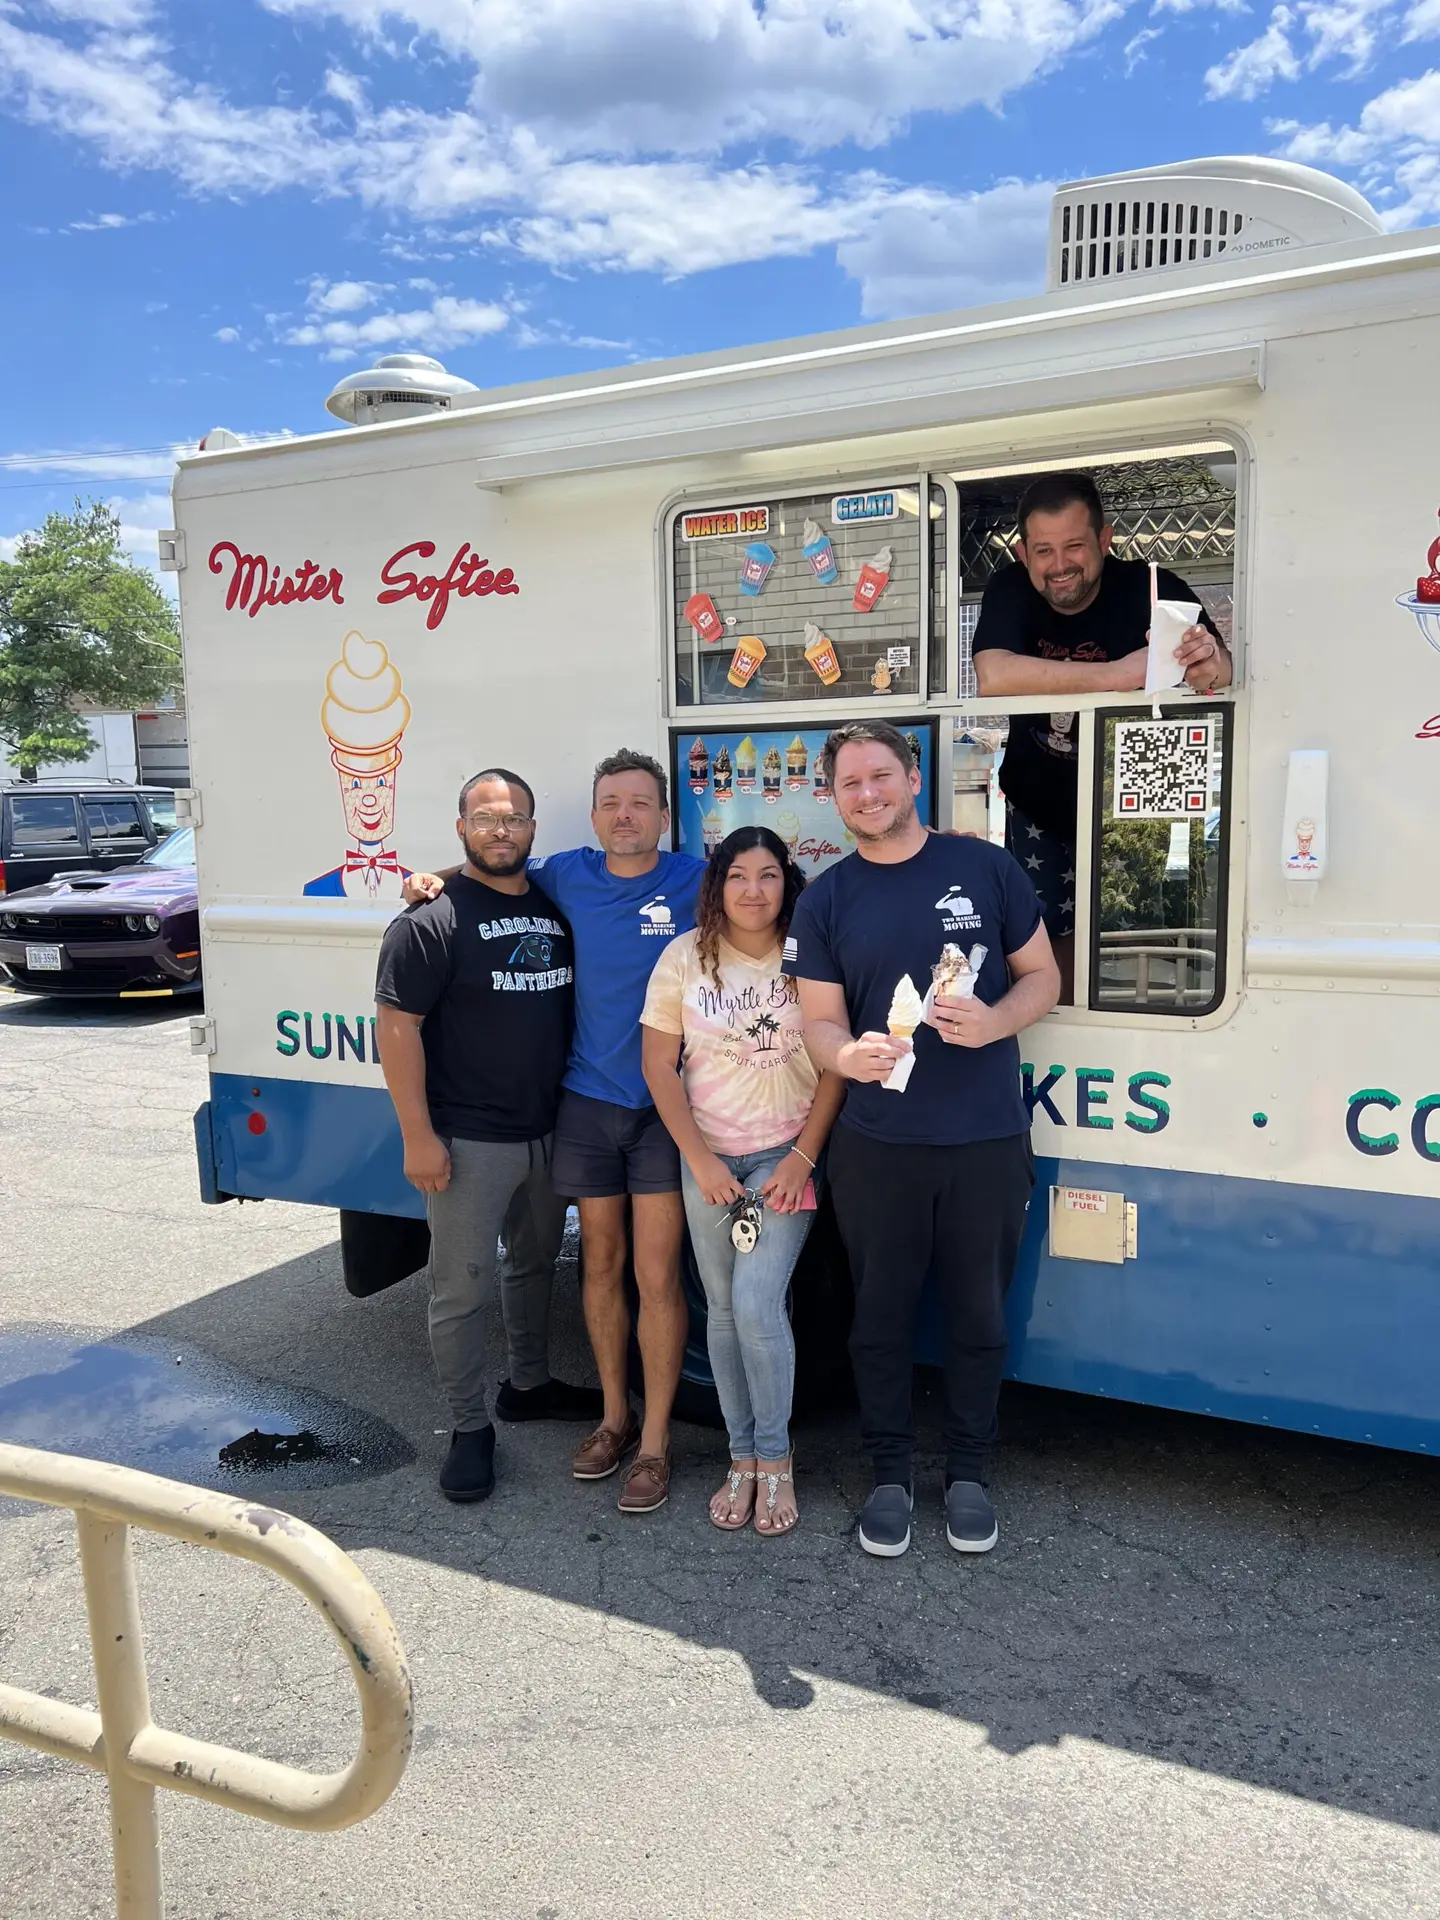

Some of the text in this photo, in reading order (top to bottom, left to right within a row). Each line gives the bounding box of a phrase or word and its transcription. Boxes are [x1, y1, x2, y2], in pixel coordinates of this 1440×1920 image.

[1244, 236, 1290, 252] DOMETIC
[836, 493, 894, 521] GELATI
[684, 509, 767, 539] WATER ICE
[208, 541, 520, 630] Mister Softee
[797, 838, 842, 863] Softee
[478, 916, 566, 940] CAROLINA
[640, 928, 676, 936] MOVING
[943, 920, 982, 931] MOVING
[491, 966, 573, 991] PANTHERS
[698, 986, 764, 1028] Myrtle
[276, 1009, 381, 1064] SUN
[724, 1043, 804, 1070] SOUTH CAROLINA
[1020, 1062, 1172, 1134] KES
[1067, 1191, 1105, 1202] DIESEL
[1072, 1201, 1100, 1212] FUEL
